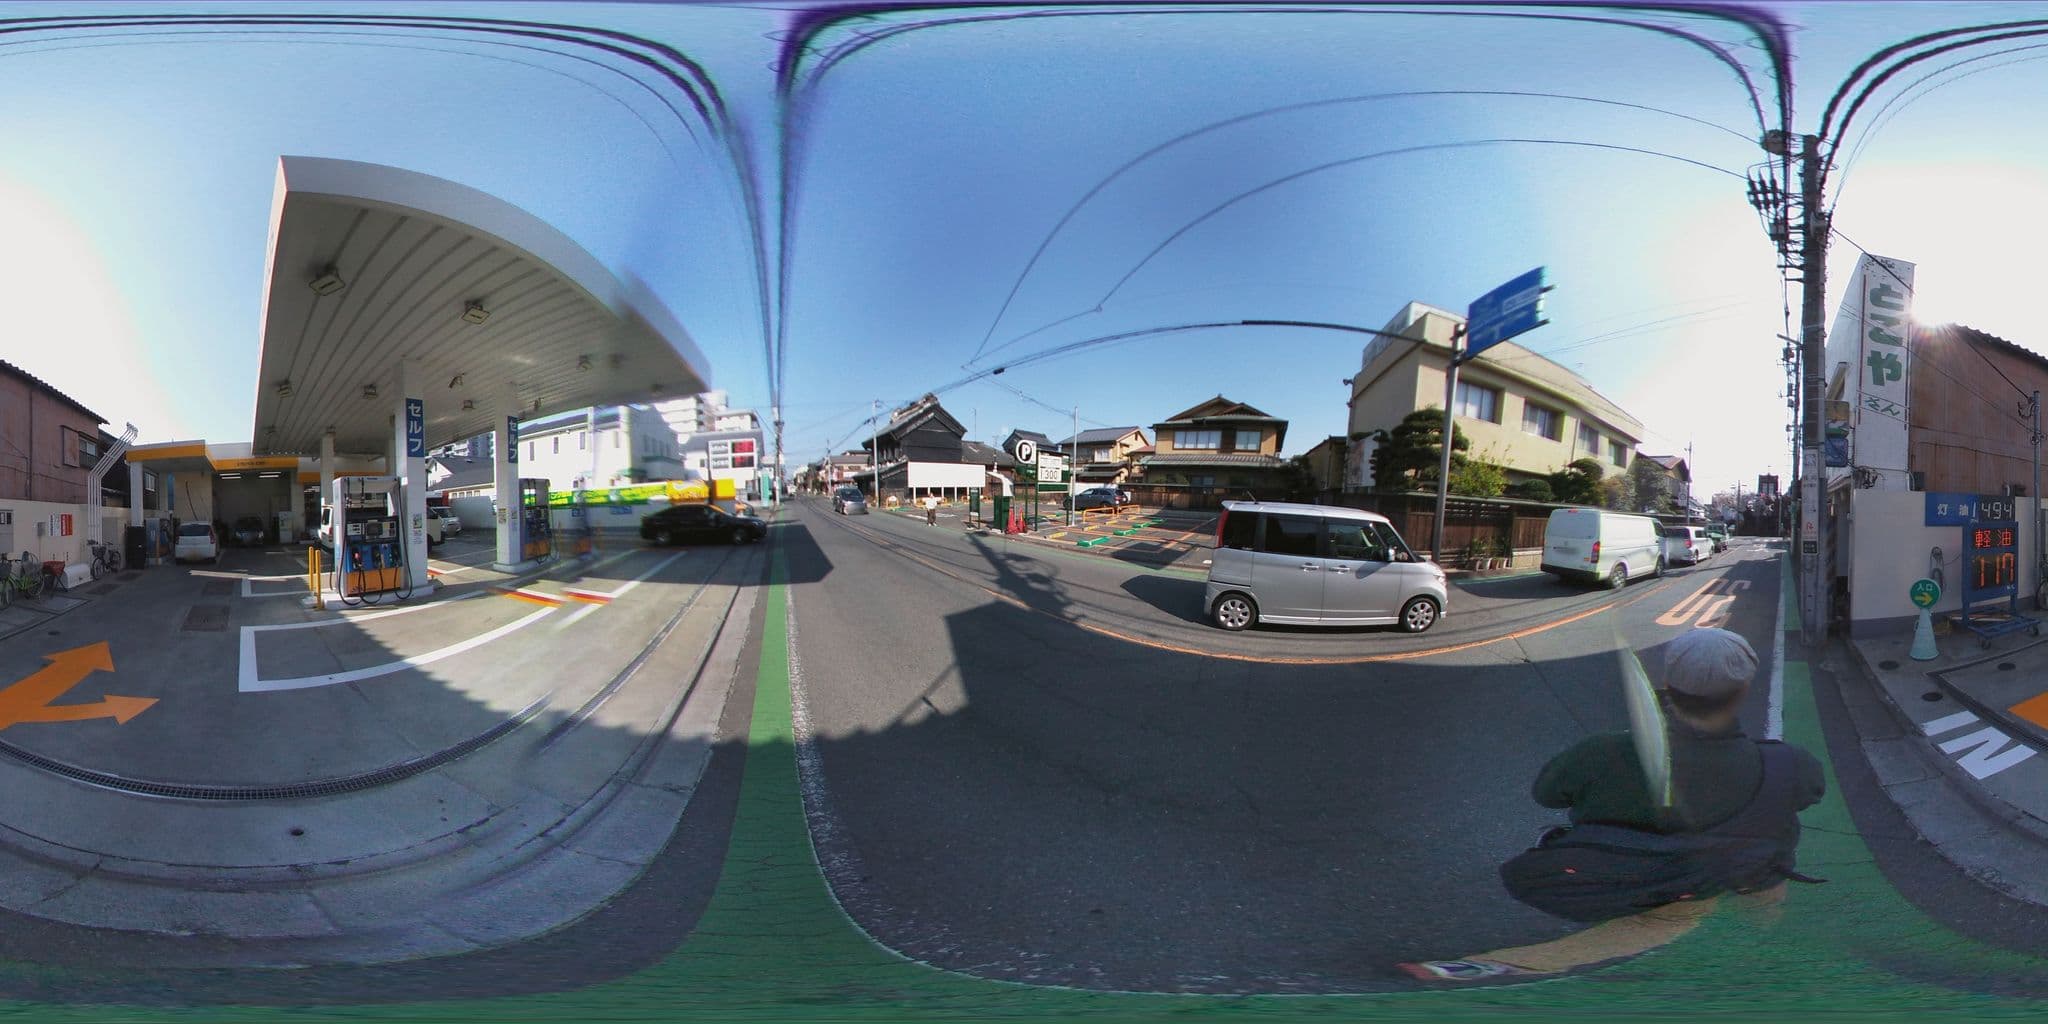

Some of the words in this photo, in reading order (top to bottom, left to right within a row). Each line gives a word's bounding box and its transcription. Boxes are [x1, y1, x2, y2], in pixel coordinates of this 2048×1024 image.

[1867, 282, 1905, 387] とこや
[408, 403, 422, 452] セルフ
[509, 420, 518, 460] セルフ
[1937, 503, 1969, 516] 灯油
[1975, 528, 2012, 549] 軽油
[1916, 583, 1933, 592] 入口
[1921, 710, 2038, 780] IN
